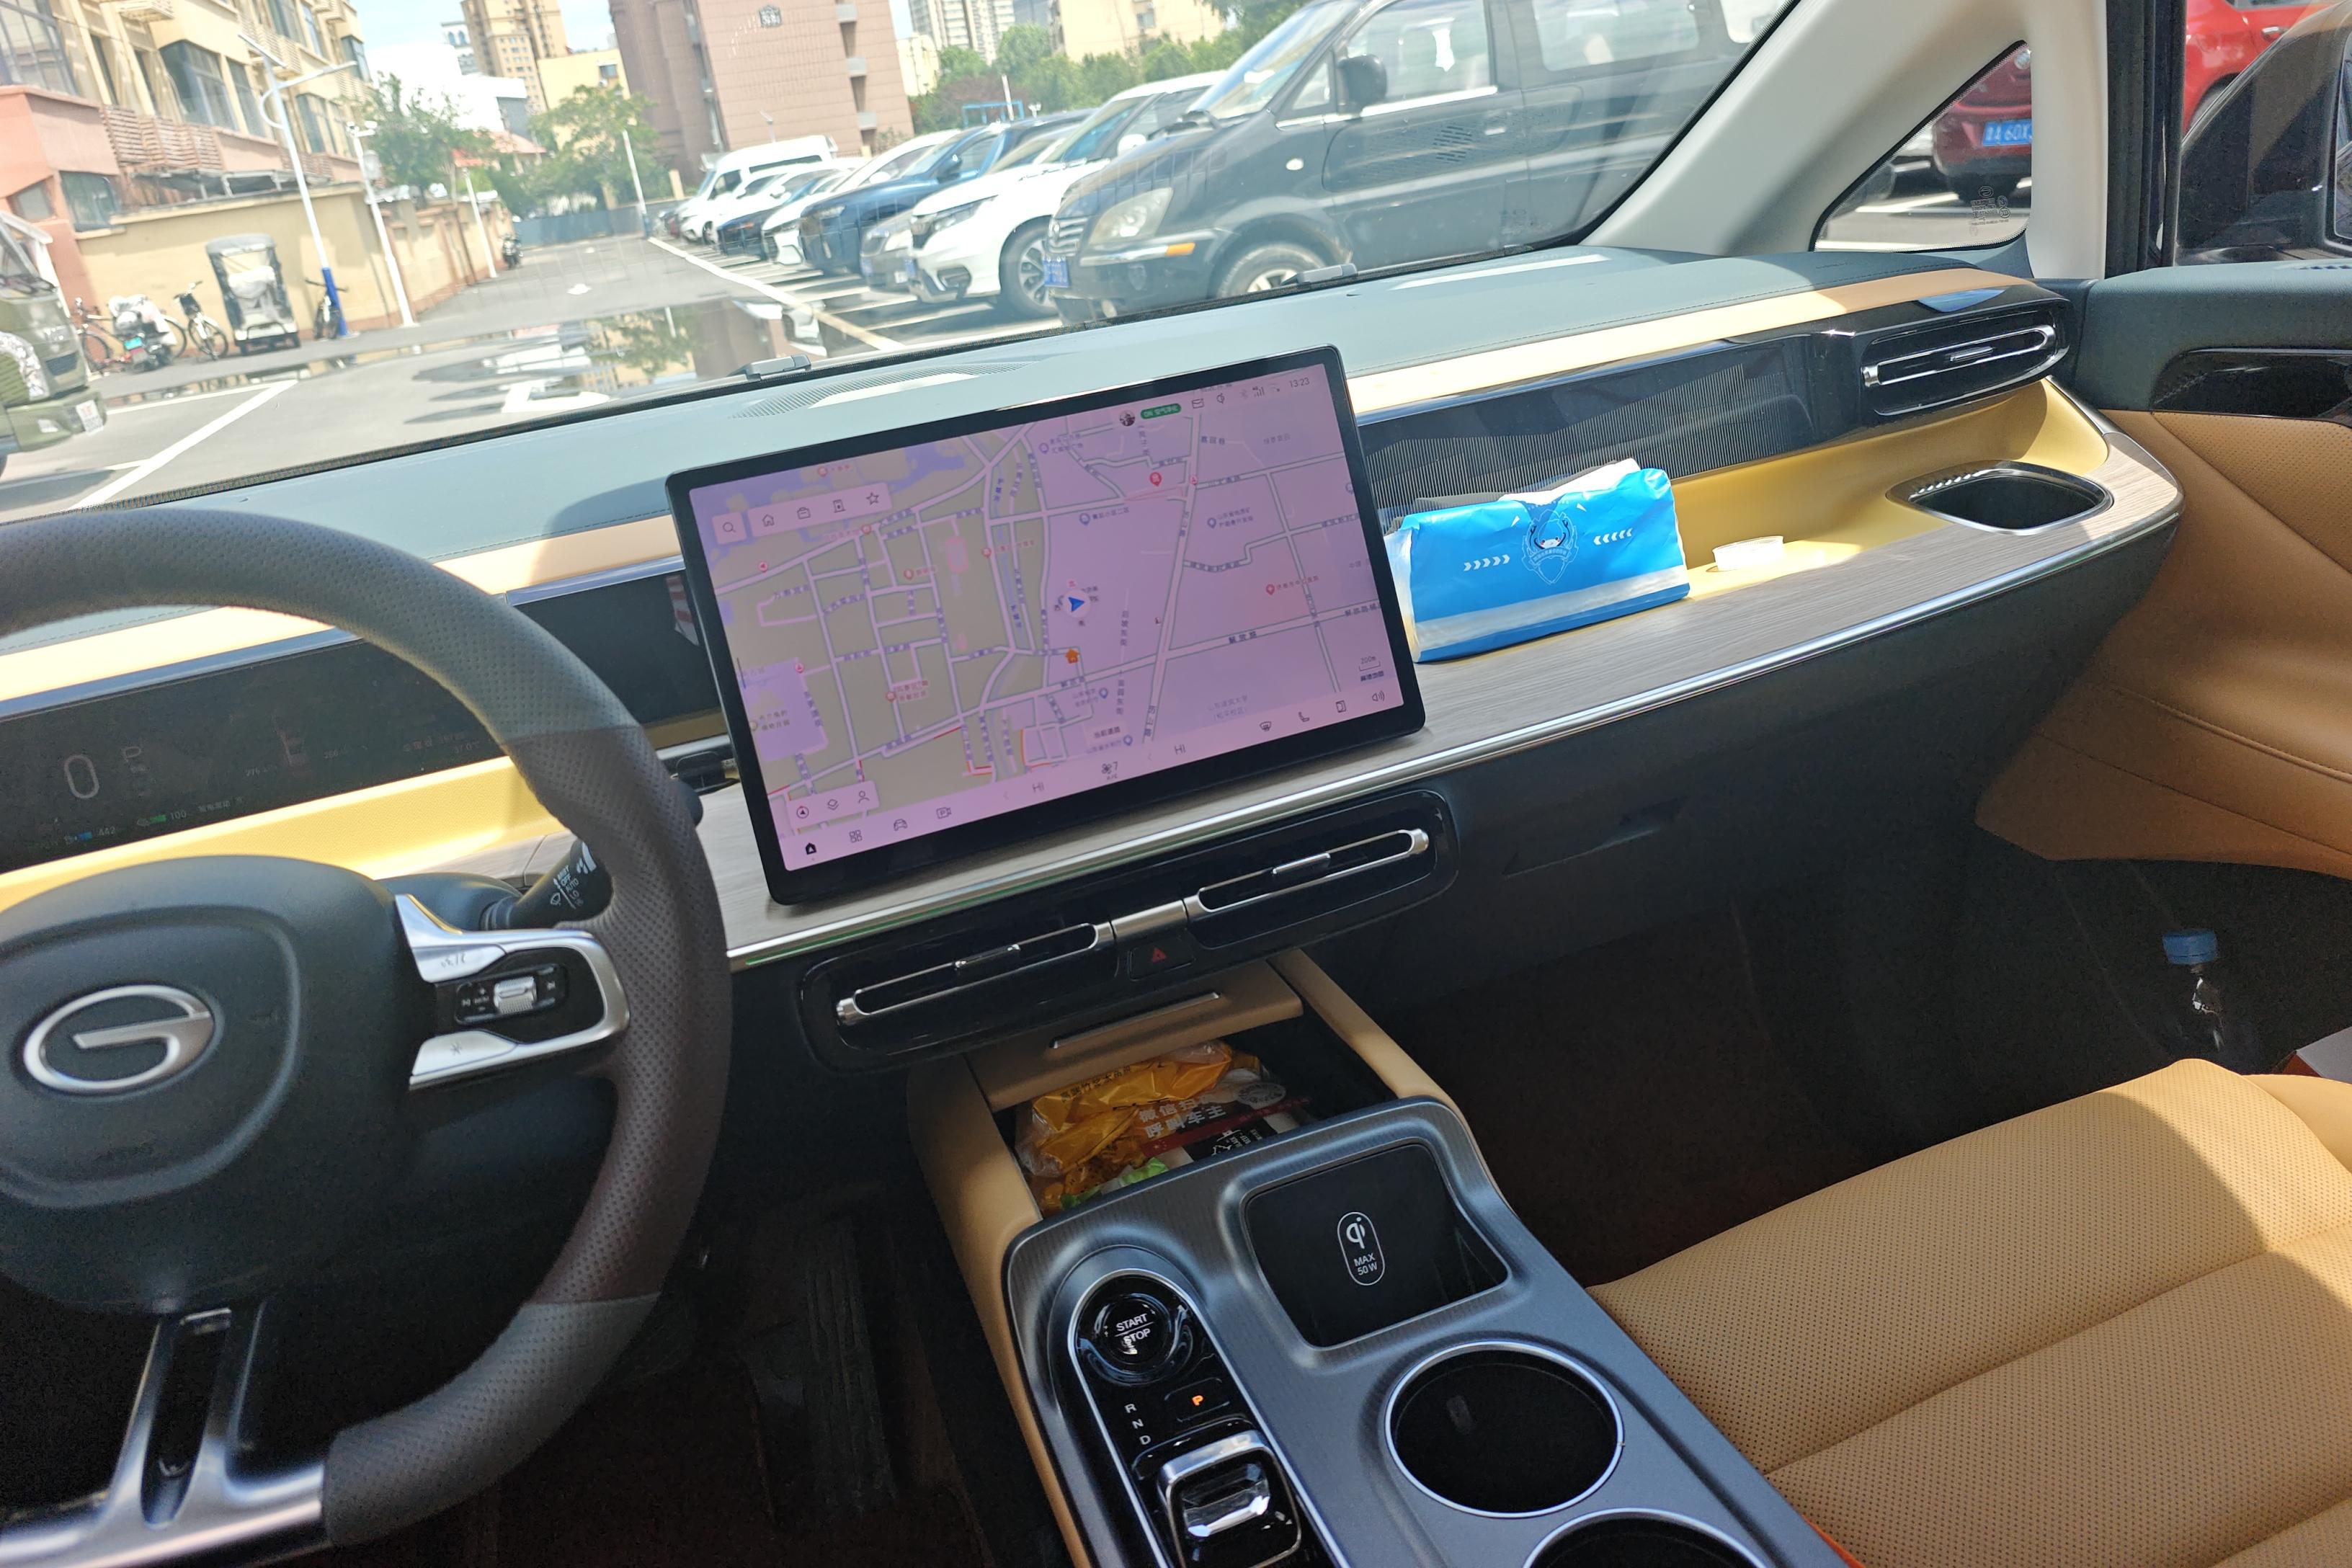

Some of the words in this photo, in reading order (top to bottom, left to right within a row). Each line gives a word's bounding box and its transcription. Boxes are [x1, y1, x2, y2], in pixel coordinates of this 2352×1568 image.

[1289, 378, 1310, 388] 13:23
[1174, 744, 1186, 755] HI
[63, 755, 99, 799] 0
[1033, 783, 1044, 793] HI
[561, 873, 571, 886] OFF
[565, 878, 579, 894] AUTO
[569, 890, 579, 900] LO
[1144, 1105, 1226, 1139] 呼叫车主
[1353, 1252, 1376, 1267] MAX
[1115, 1313, 1148, 1332] START
[1123, 1328, 1151, 1342] STOP
[1192, 1394, 1204, 1406] P
[1124, 1403, 1137, 1413] R
[1132, 1418, 1144, 1429] N
[1139, 1435, 1152, 1446] D
